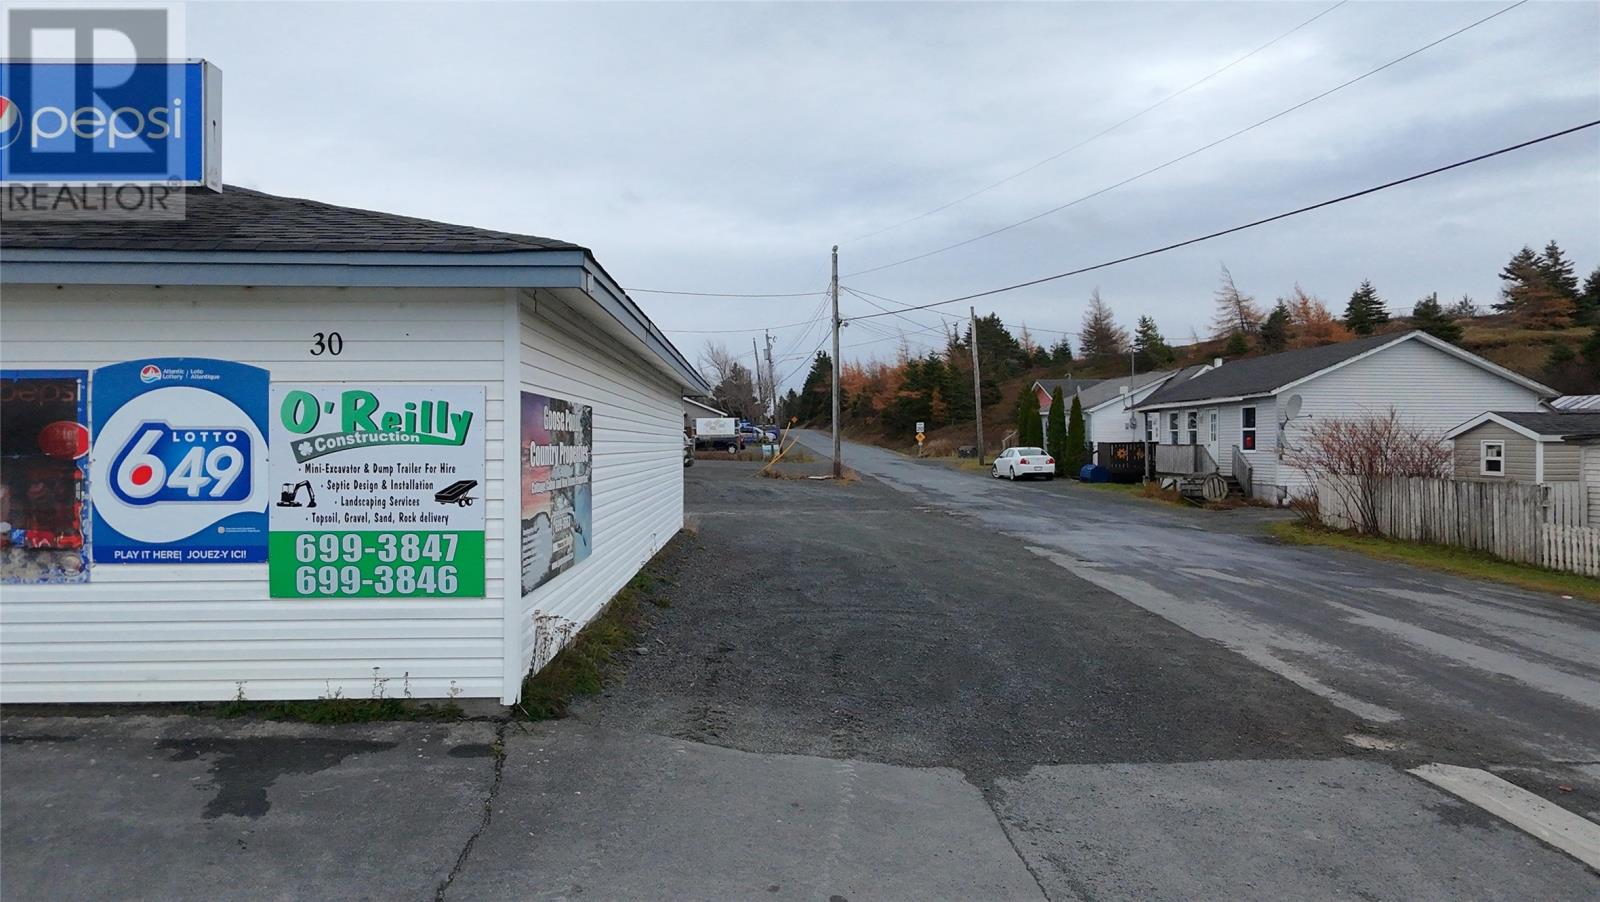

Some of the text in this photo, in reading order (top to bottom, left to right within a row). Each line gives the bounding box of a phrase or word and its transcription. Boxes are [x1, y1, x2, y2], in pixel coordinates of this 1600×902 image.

[31, 98, 182, 149] pepsi
[310, 332, 343, 356] 30
[281, 390, 474, 447] O'Reilly
[544, 405, 565, 430] Goose
[172, 432, 237, 442] LOTTO
[314, 432, 420, 452] Construction
[530, 440, 559, 467] Country
[304, 462, 456, 477] Mini-Excavator & Dump Trailer For Hire
[326, 479, 434, 493] Septic Design & Installation
[340, 496, 420, 509] Landscaping Services
[311, 512, 449, 526] Topsoil, Gravel, Sand, Rock delivery
[114, 550, 140, 559] PLAY
[141, 550, 151, 559] IT
[186, 550, 229, 559] JOUEZ-Y
[295, 533, 459, 563] 699-3847
[295, 565, 458, 595] 699-3846
